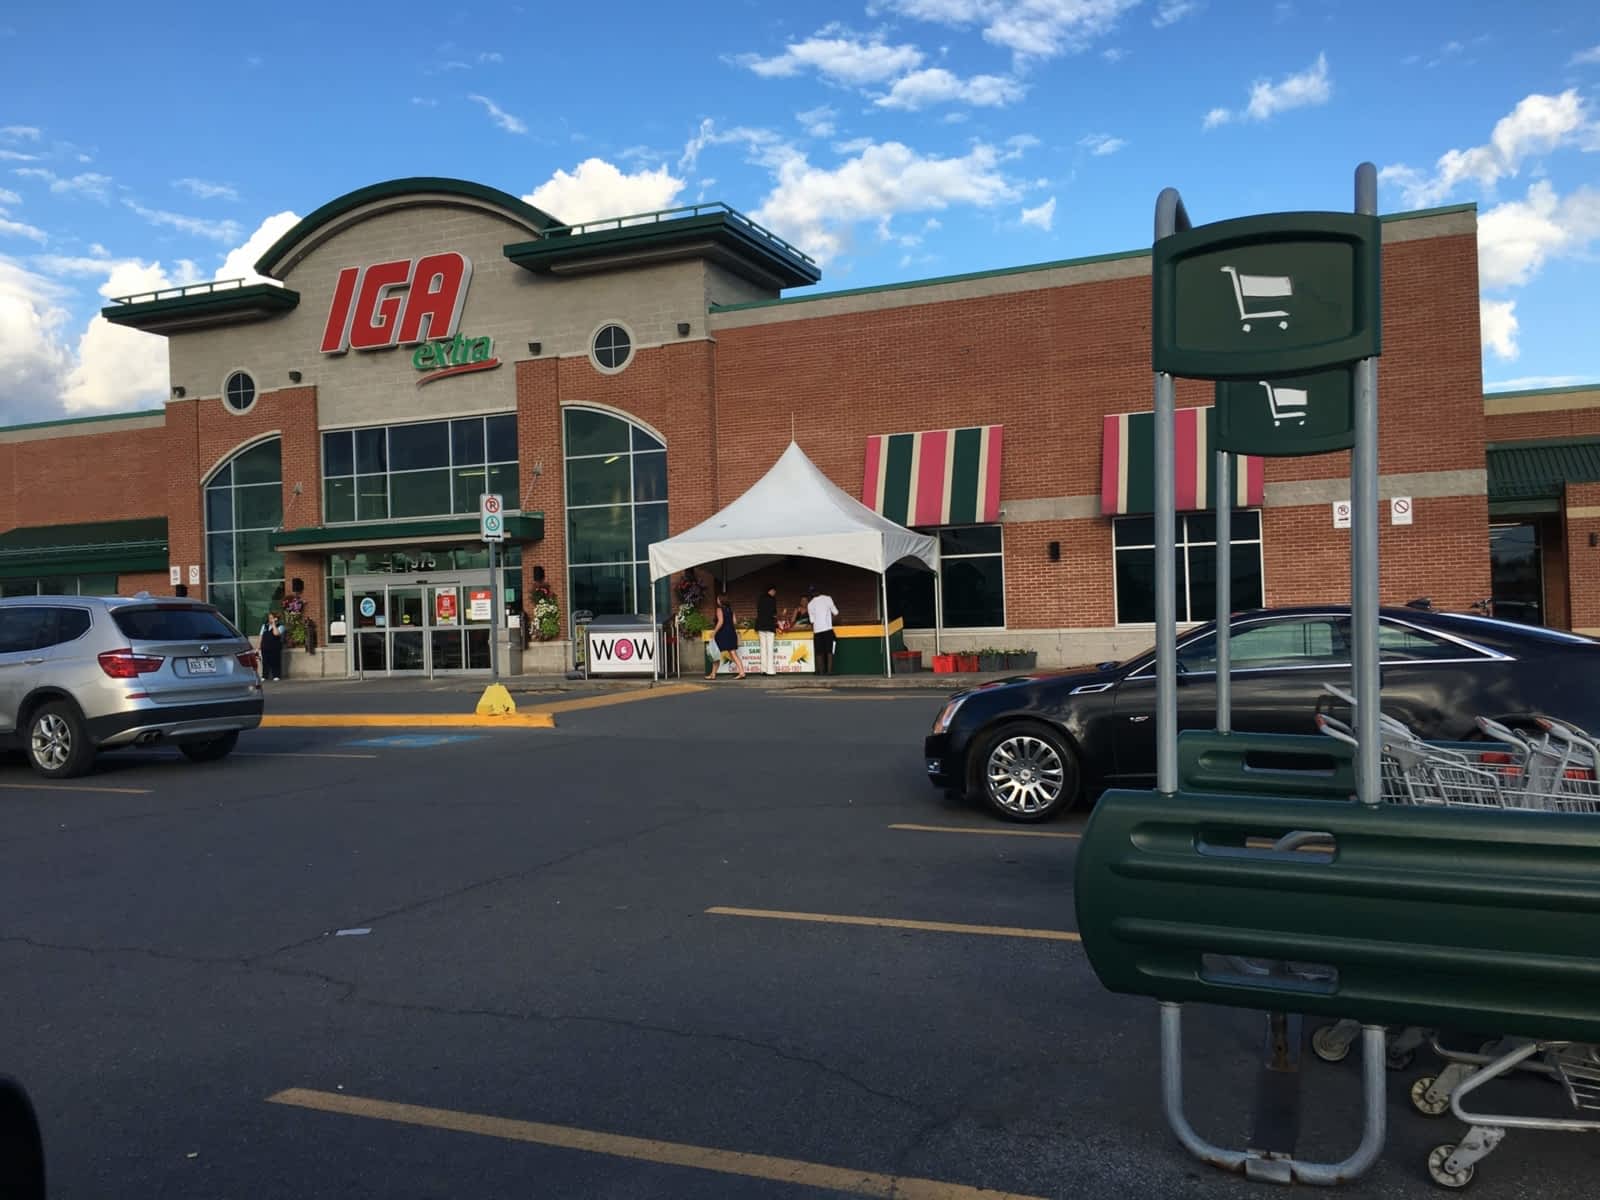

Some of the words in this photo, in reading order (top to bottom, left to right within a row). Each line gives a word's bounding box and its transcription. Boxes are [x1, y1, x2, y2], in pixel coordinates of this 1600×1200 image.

[320, 251, 472, 354] IGA
[411, 333, 494, 370] extra
[592, 638, 655, 661] WOW
